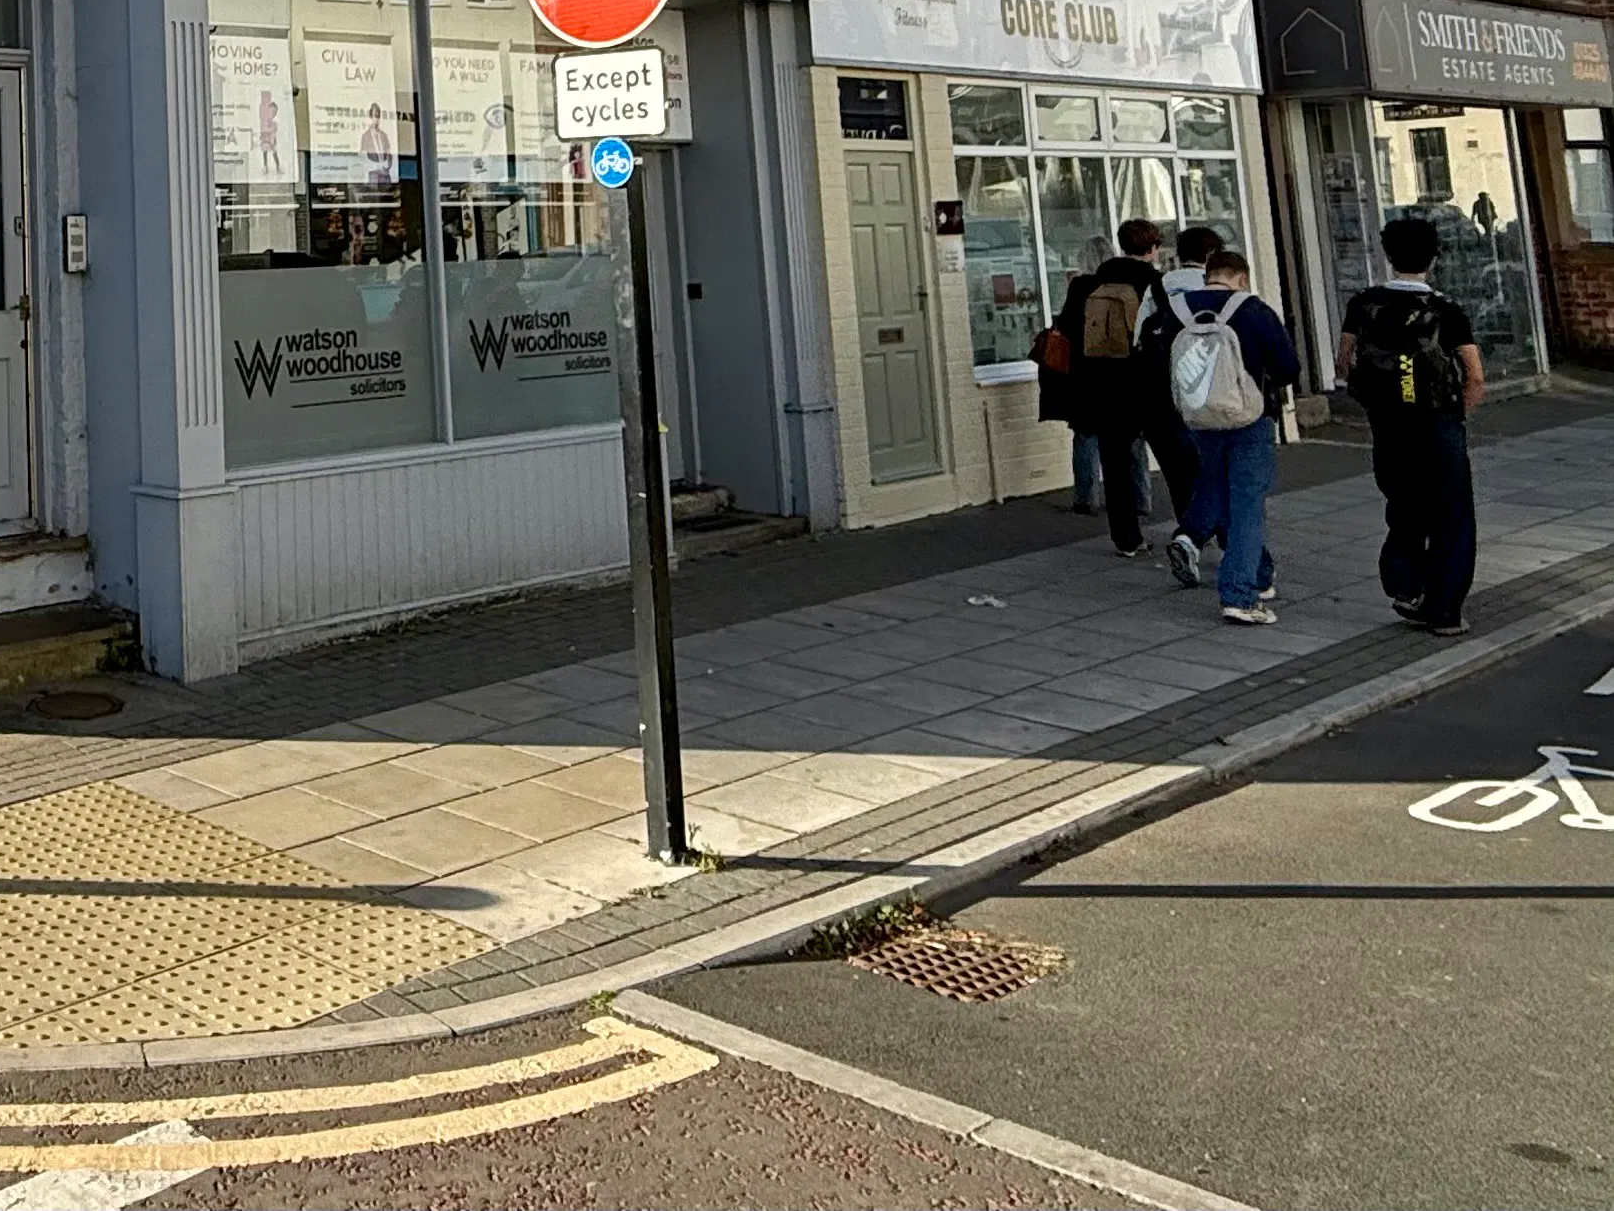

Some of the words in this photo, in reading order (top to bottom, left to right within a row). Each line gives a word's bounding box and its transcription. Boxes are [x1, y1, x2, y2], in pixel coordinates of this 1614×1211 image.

[1064, 2, 1119, 45] CLUB
[1417, 9, 1480, 52] SMITH
[1493, 21, 1566, 62] FRIENDS
[322, 49, 357, 64] CIVIL
[443, 56, 466, 69] YOU
[468, 58, 495, 71] NEED
[234, 62, 279, 76] HOME?
[345, 67, 377, 82] LAW
[449, 70, 457, 81] A
[459, 71, 490, 83] WILL?
[566, 62, 652, 92] Except
[1442, 58, 1497, 81] ESTATE
[1504, 64, 1556, 86] AGENTS
[571, 97, 649, 127] cycles
[510, 309, 570, 330] watson
[284, 328, 358, 353] watson
[511, 329, 607, 353] woodhouse
[286, 349, 402, 377] woodhouse
[565, 355, 612, 371] solicitors
[350, 377, 406, 396] solicitors
